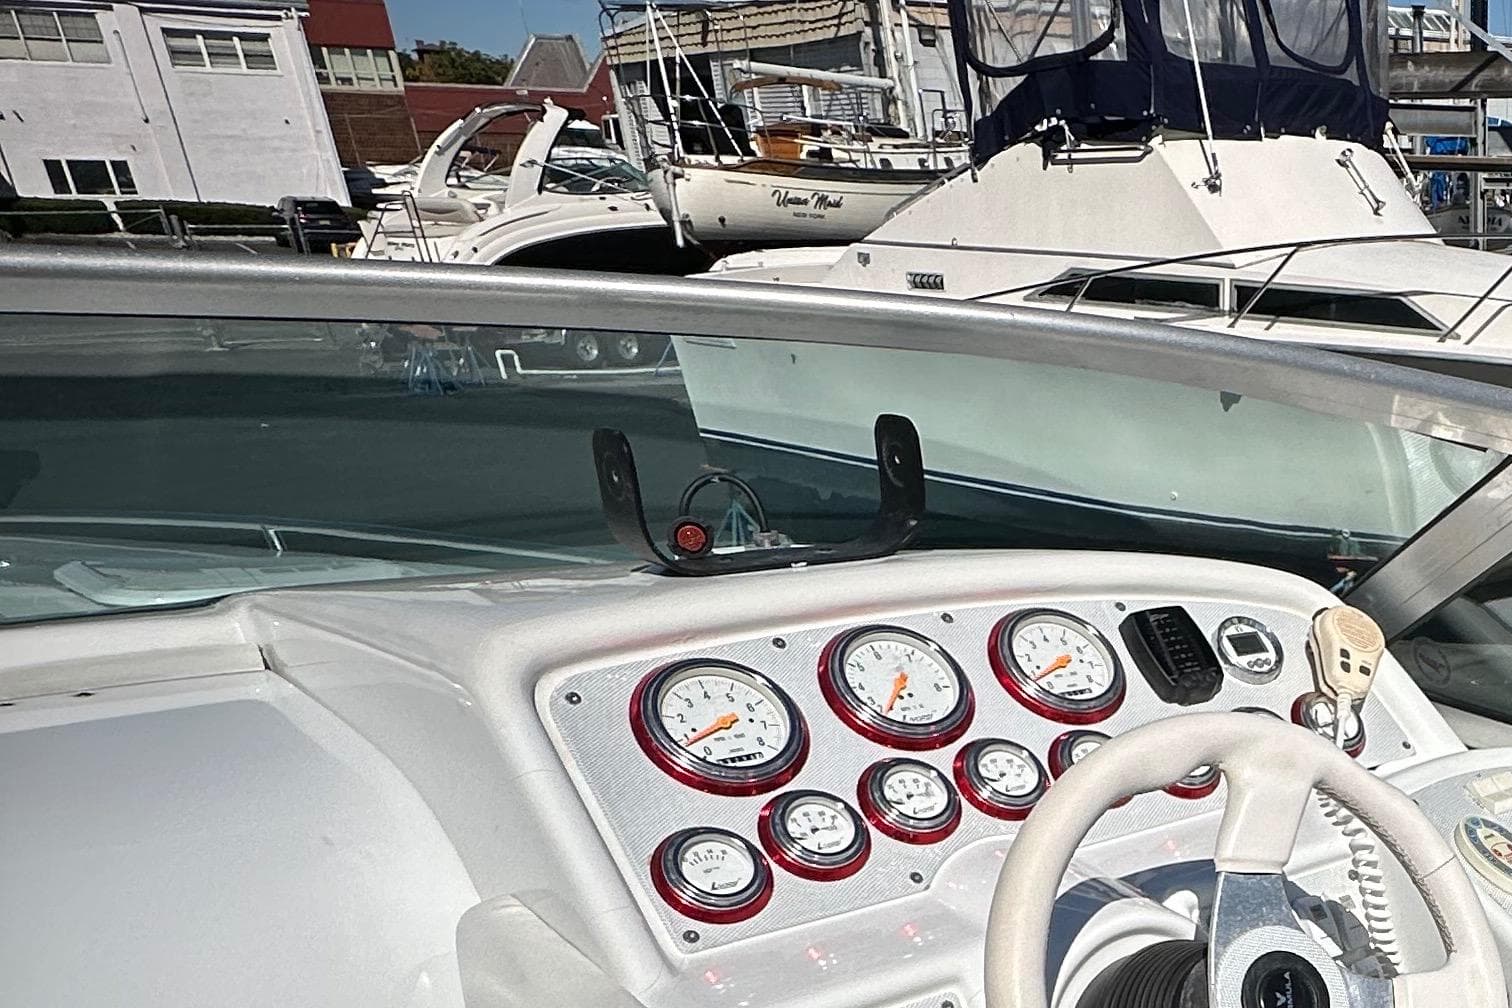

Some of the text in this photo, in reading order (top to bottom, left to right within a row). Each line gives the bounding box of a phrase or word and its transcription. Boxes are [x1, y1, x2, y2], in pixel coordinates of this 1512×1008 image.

[703, 691, 711, 701] 4
[726, 692, 735, 703] 5
[685, 698, 694, 709] 3
[746, 702, 755, 712] 6
[677, 713, 686, 724] 2
[760, 720, 768, 730] 7
[756, 736, 765, 746] 8
[703, 746, 712, 756] 0
